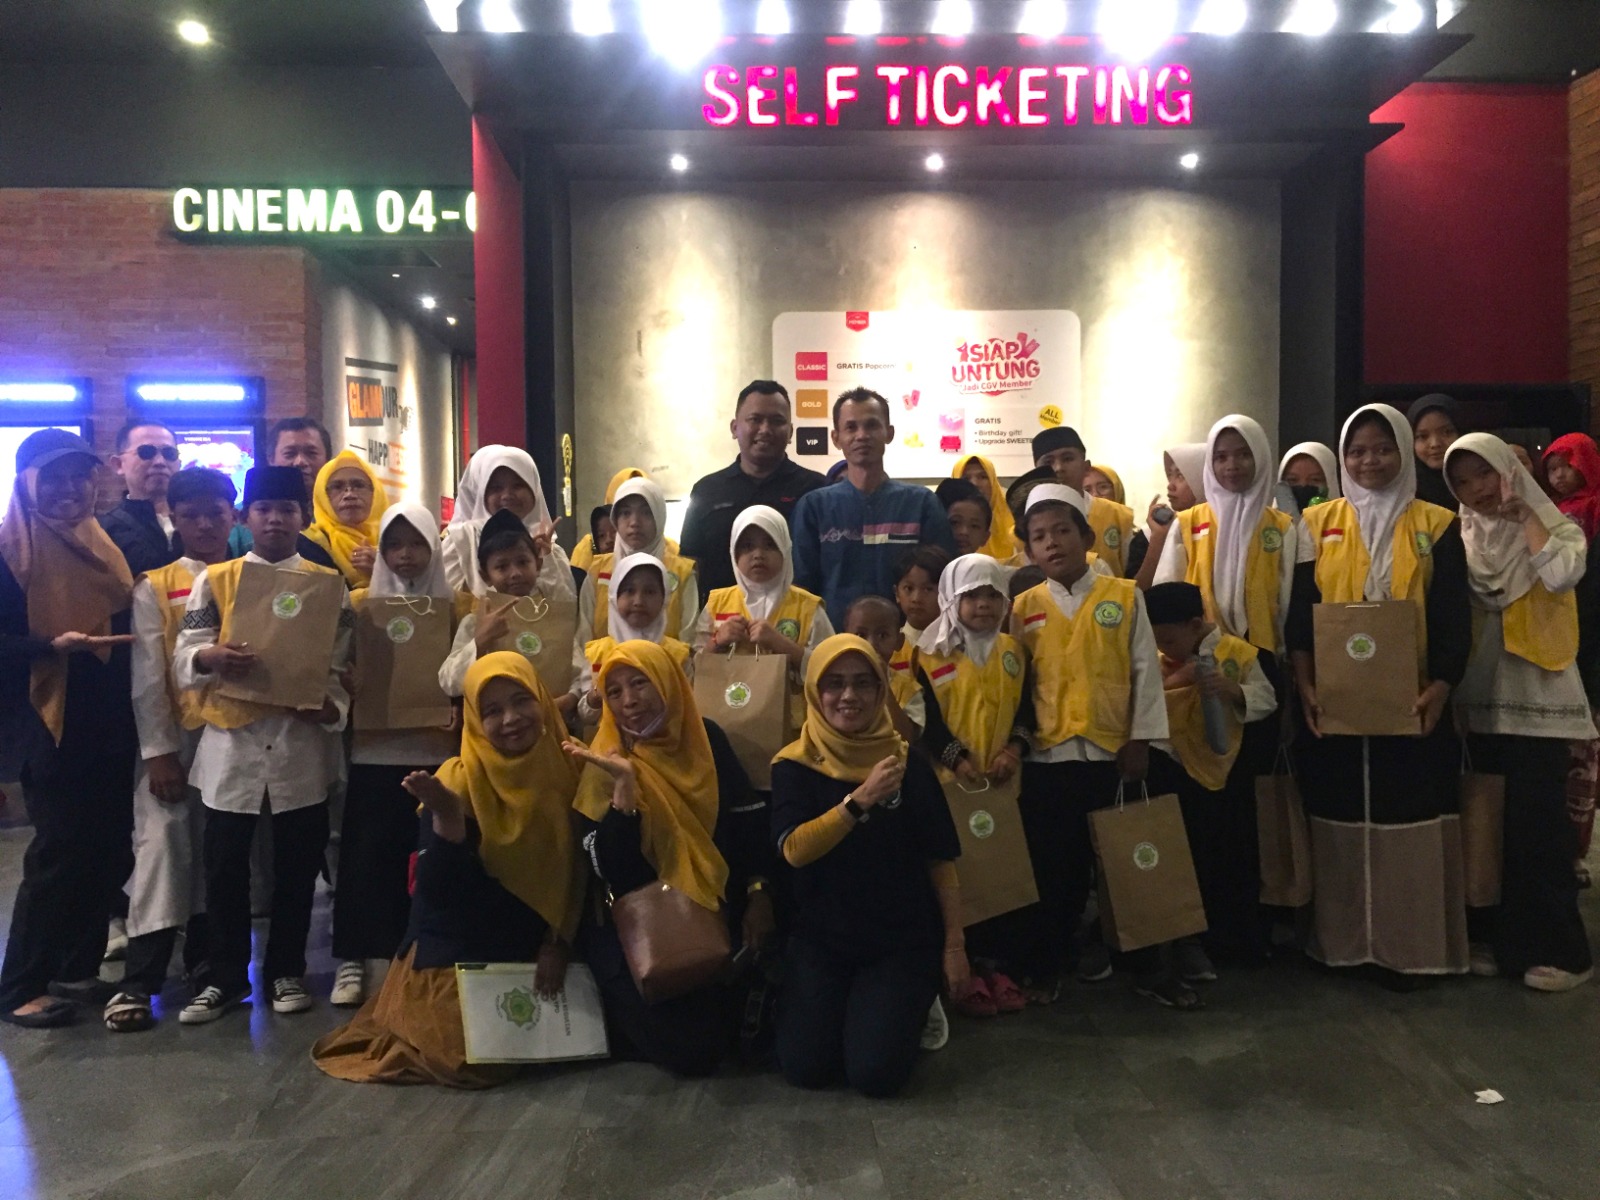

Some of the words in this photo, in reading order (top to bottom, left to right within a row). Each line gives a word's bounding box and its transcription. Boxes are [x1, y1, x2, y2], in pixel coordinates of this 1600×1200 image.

[702, 64, 860, 126] SELF
[876, 64, 1192, 126] TICKETING
[172, 187, 363, 232] CINEMA
[970, 341, 1019, 362] SIAP
[951, 359, 1040, 382] UNTUNG
[963, 384, 980, 392] Jadi
[981, 382, 998, 390] CGV
[999, 379, 1032, 388] Member
[1044, 408, 1059, 420] ALL
[978, 429, 1007, 437] Birthday
